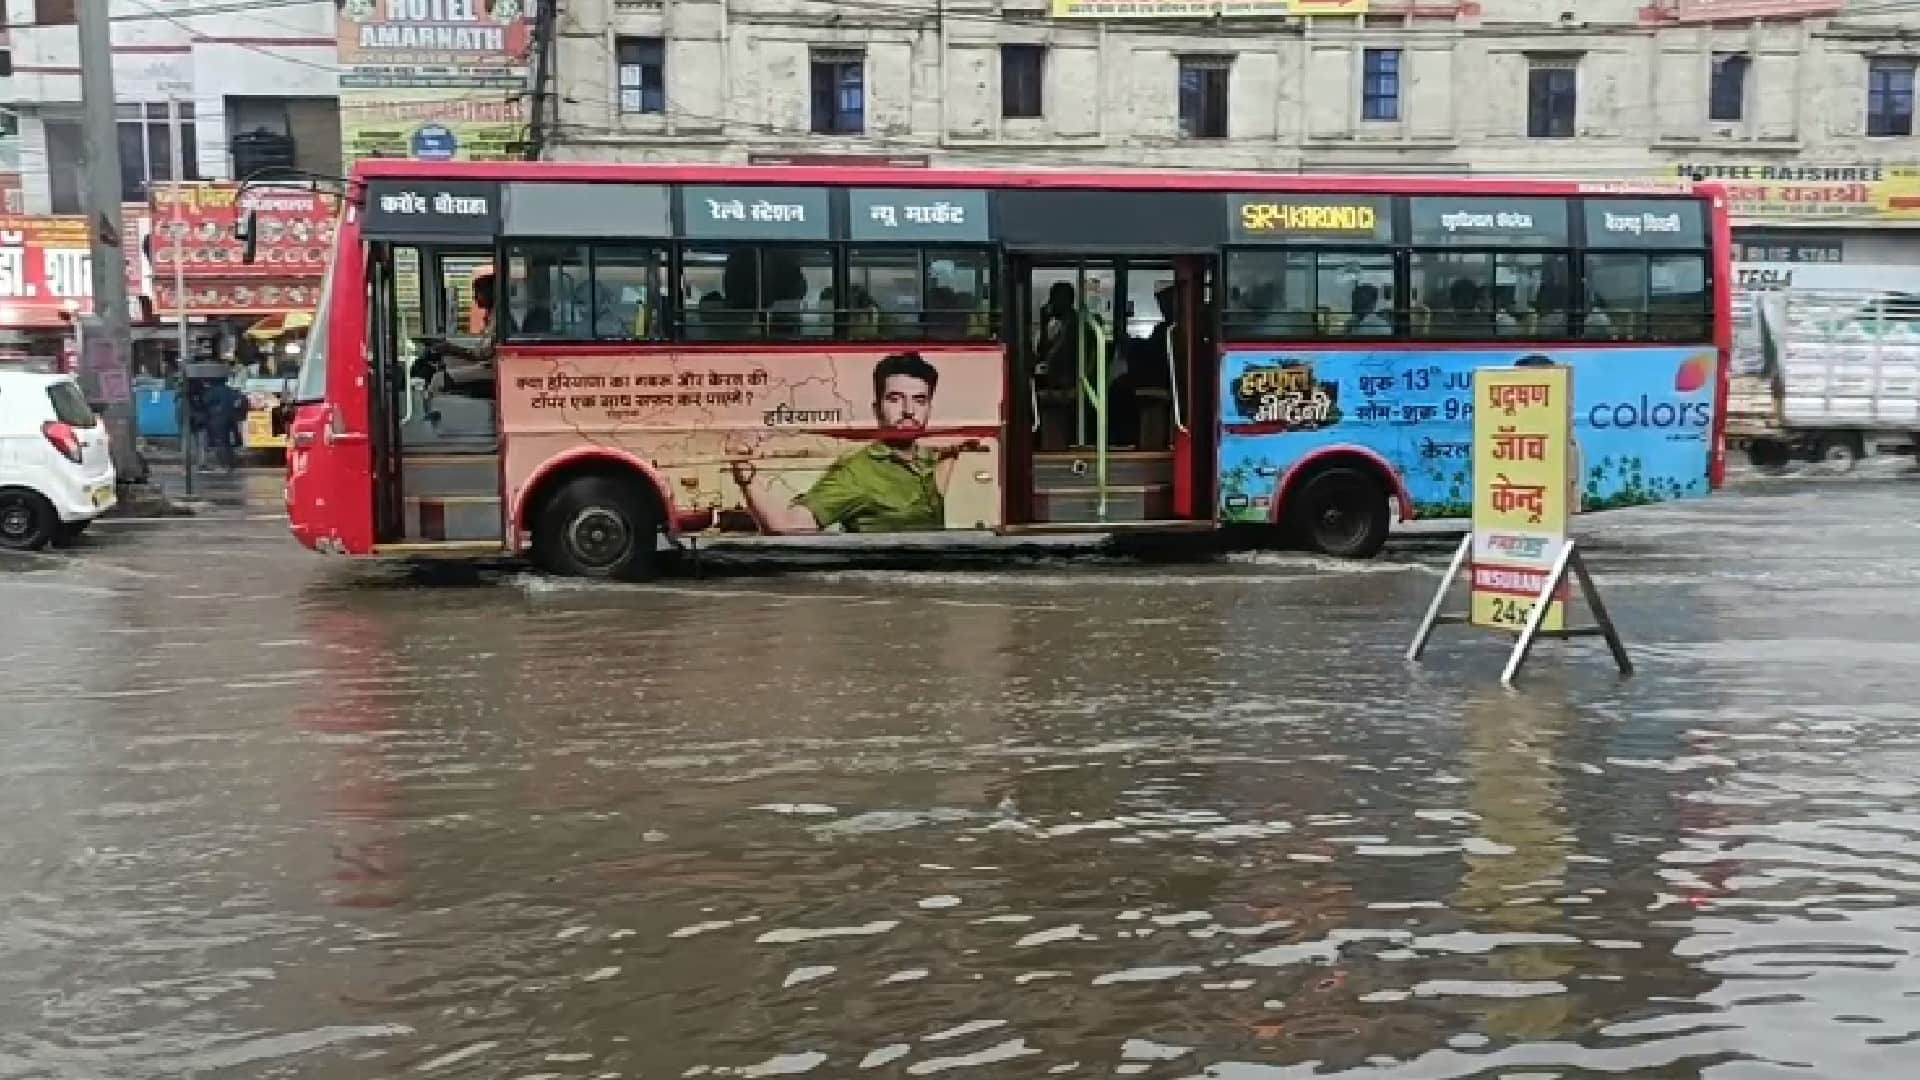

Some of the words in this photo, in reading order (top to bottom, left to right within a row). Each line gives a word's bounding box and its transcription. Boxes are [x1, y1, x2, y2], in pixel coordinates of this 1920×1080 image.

[359, 26, 503, 50] AMARNATH
[1678, 165, 1753, 180] HOTEL
[1761, 165, 1883, 181] RAJSHREE
[751, 201, 806, 222] स्टेशन
[870, 205, 898, 227] न्यू
[1241, 204, 1287, 229] SR4
[547, 372, 605, 391] हरियाणा
[609, 376, 629, 387] का
[677, 370, 704, 386] और
[708, 369, 743, 386] केरल
[747, 369, 767, 386] की
[531, 393, 566, 409] टॉपर
[570, 395, 596, 408] एक
[677, 393, 701, 408] कर
[1489, 384, 1550, 416] प्रदूषण
[1589, 394, 1709, 430] colors
[762, 402, 841, 427] हरियाणा
[1489, 472, 1546, 524] केन्द्र
[1492, 598, 1536, 625] 24x
